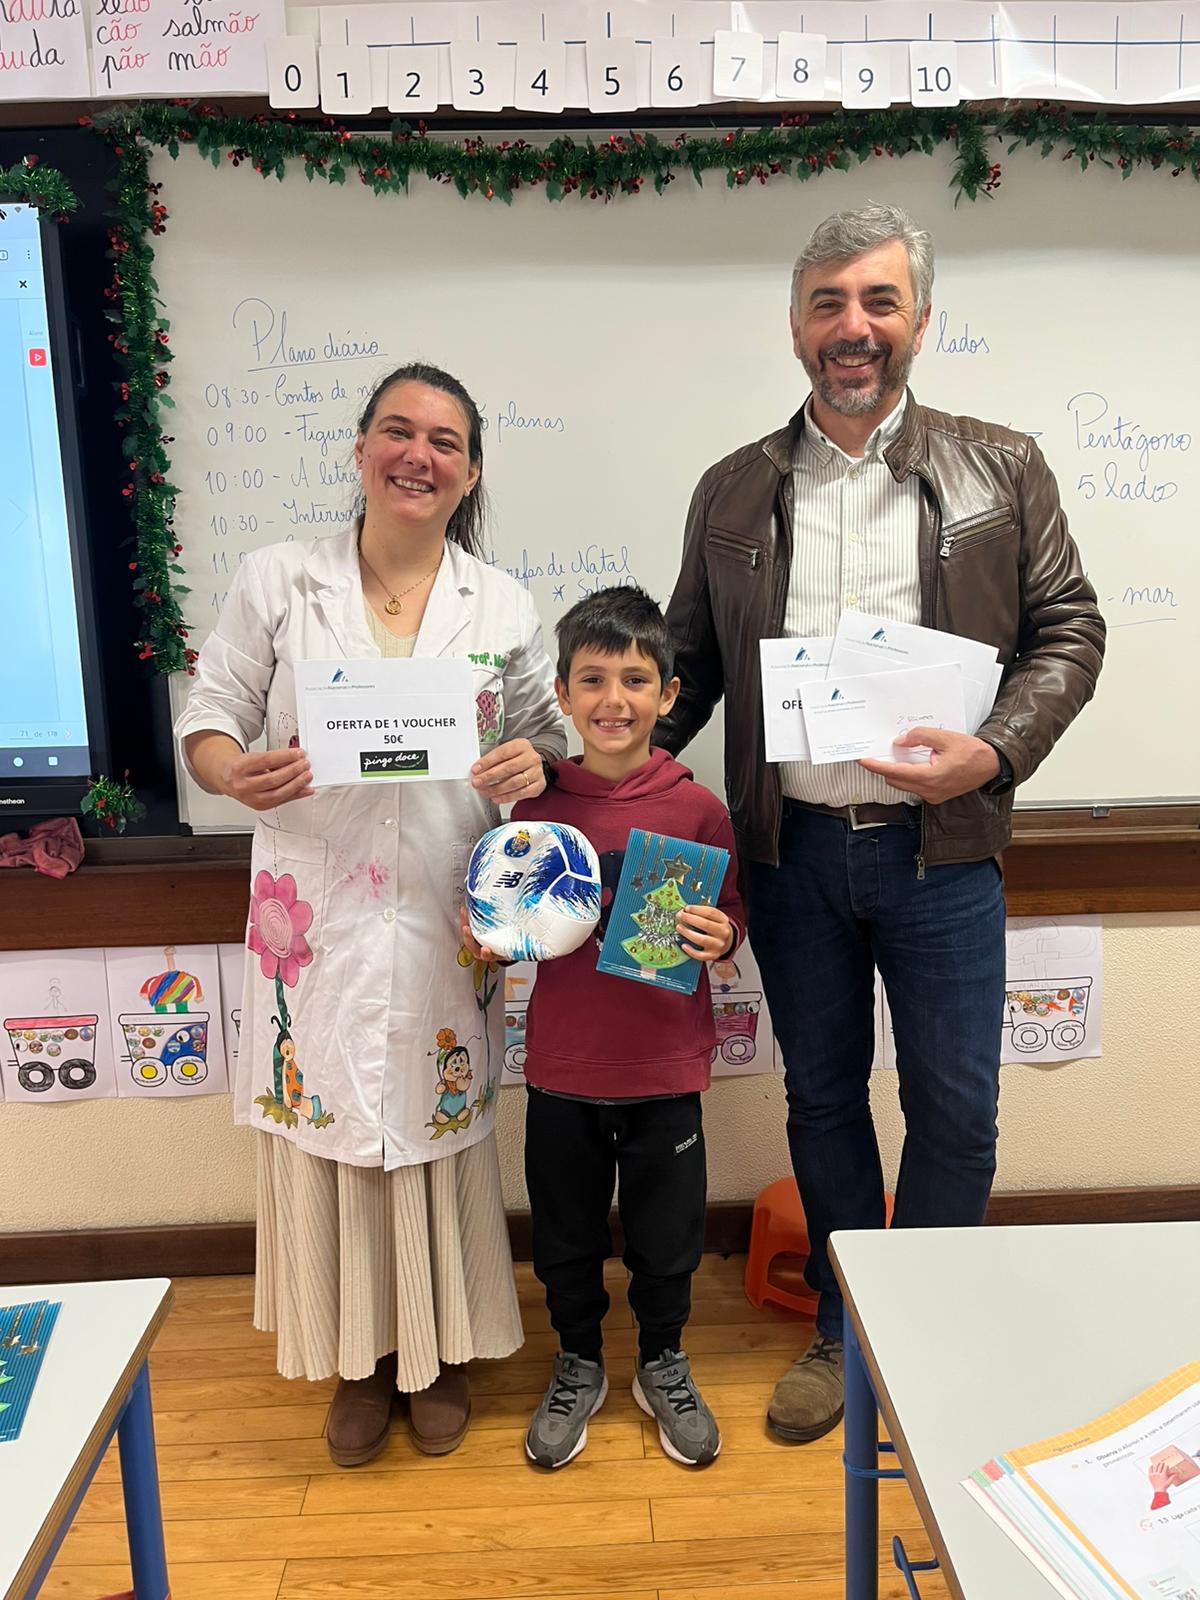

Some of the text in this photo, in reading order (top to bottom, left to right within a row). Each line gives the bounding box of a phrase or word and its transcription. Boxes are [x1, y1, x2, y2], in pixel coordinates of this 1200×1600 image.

[97, 6, 260, 45] cão salmão
[101, 42, 231, 89] pão mão
[285, 56, 952, 98] 0 1 2 3 4 5 6 7 8 9 10
[232, 297, 379, 364] Plano diário
[936, 311, 990, 353] lados
[331, 379, 347, 400] de
[295, 412, 358, 457] Figura
[498, 400, 565, 443] planas
[1067, 392, 1192, 472] Pentágono
[205, 468, 265, 495] 10:00
[290, 456, 310, 489] A
[1077, 474, 1096, 499] 5
[210, 514, 258, 536] 10:30
[571, 544, 631, 575] Natal
[1121, 586, 1178, 607] mar
[326, 717, 457, 731] OFERTA DE 1 VOUCHER
[383, 734, 404, 745] 50€
[363, 755, 393, 771] pingo
[394, 751, 420, 763] doce
